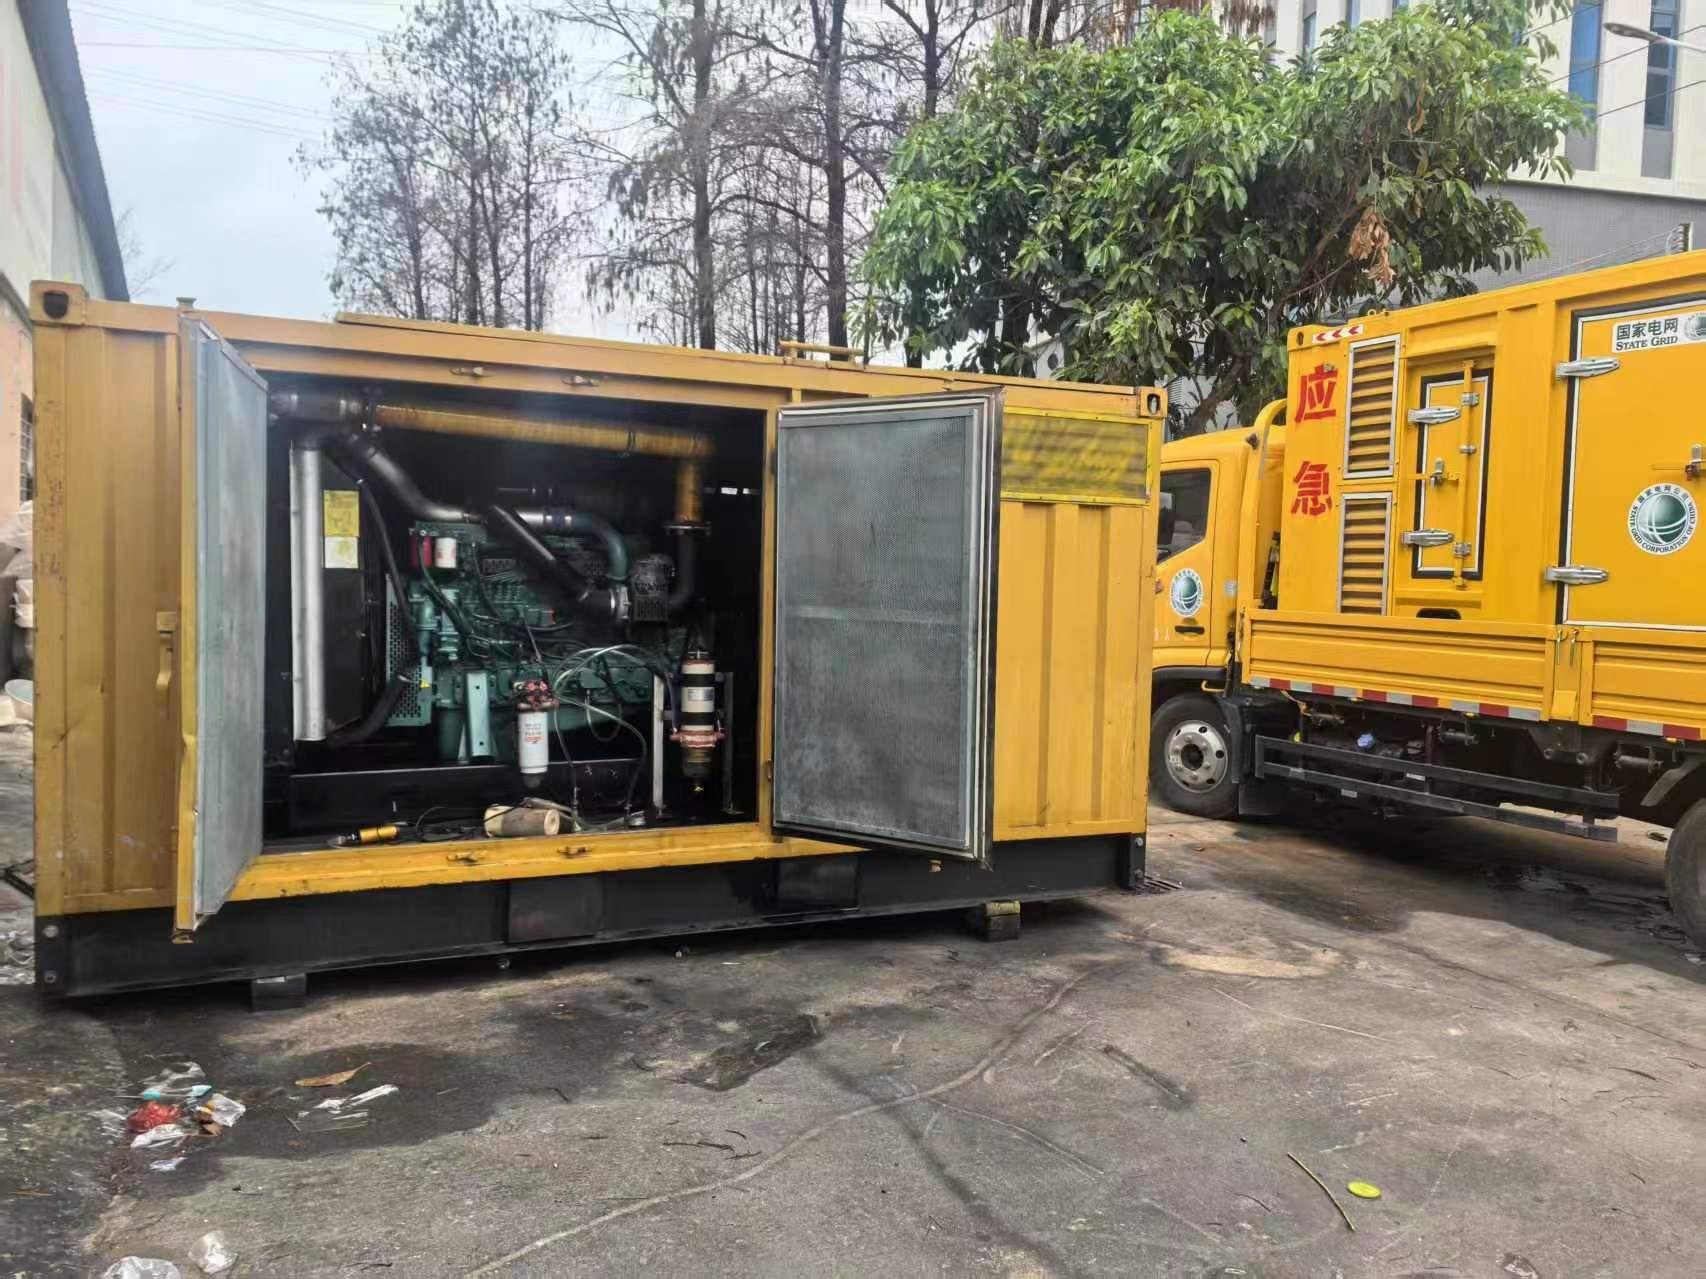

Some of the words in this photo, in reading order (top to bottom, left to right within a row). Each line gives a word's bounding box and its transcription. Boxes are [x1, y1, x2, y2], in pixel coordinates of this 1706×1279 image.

[1616, 317, 1678, 340] 国家电网
[1616, 340, 1648, 351] STATE
[1651, 336, 1678, 346] GRID
[1290, 363, 1338, 516] 应急
